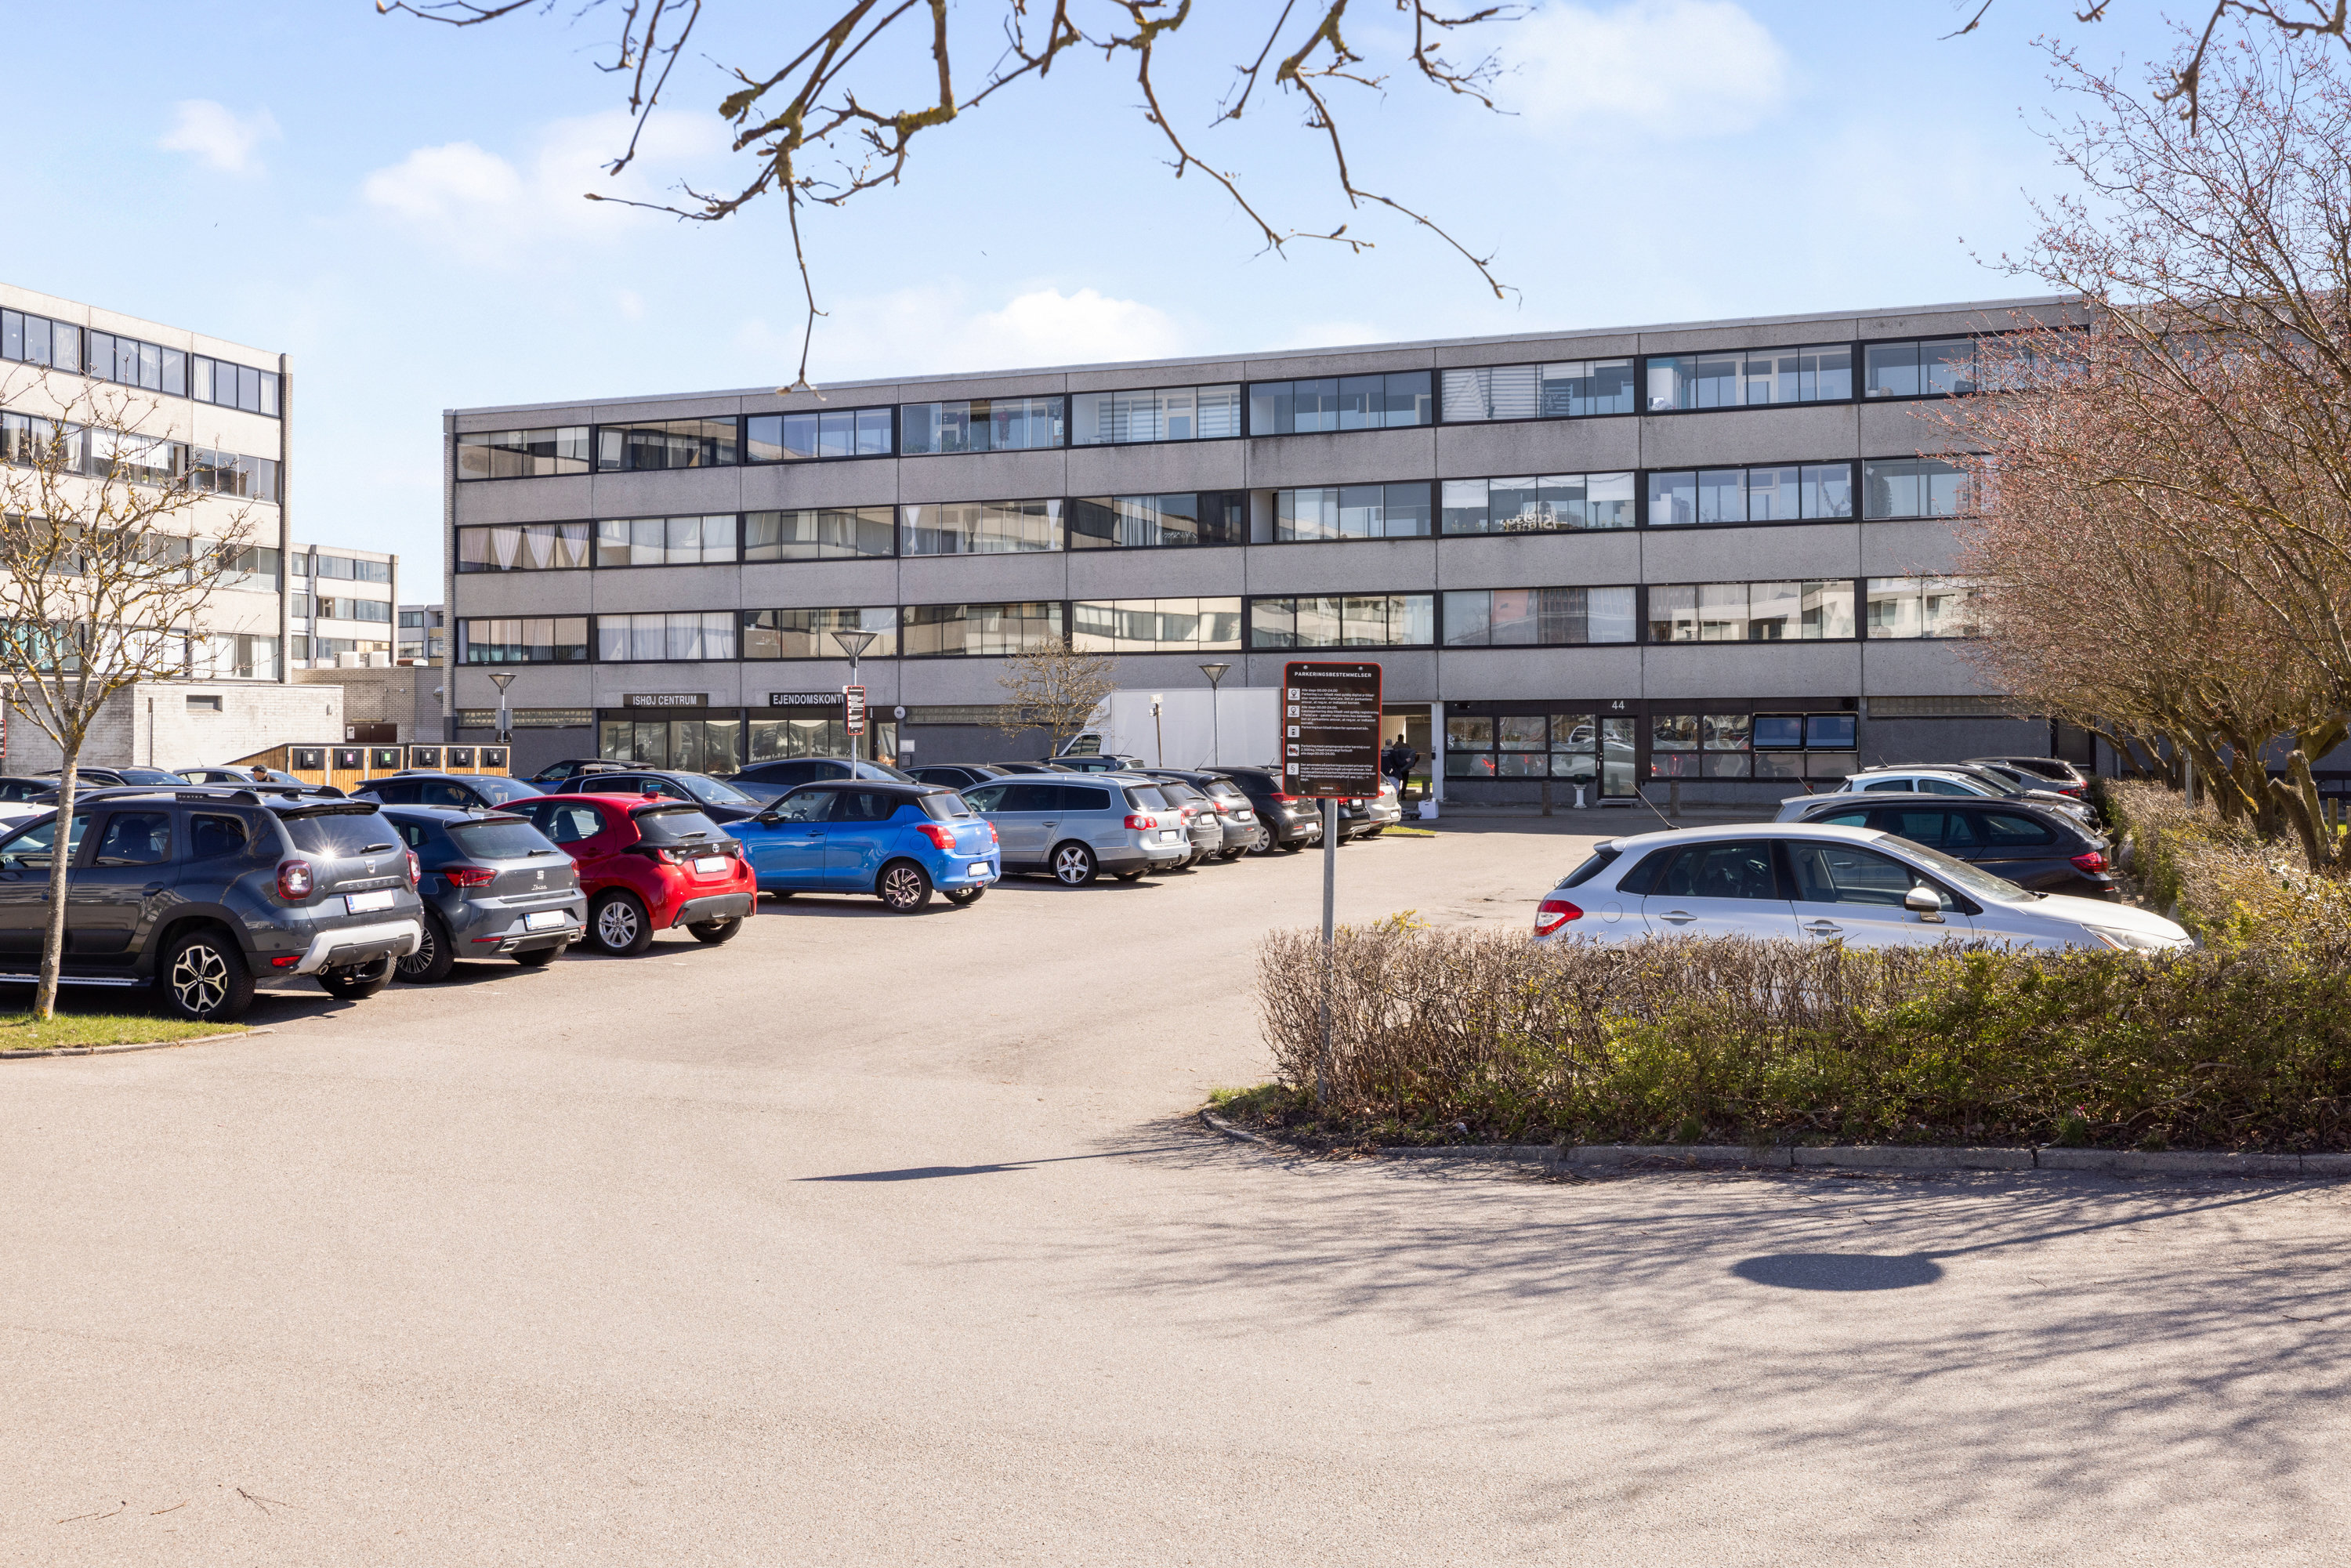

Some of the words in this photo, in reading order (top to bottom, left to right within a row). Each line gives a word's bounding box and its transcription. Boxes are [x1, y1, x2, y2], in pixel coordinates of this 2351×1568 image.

[633, 695, 656, 705] ISHØJ
[658, 695, 697, 705] CENTRUM
[773, 694, 843, 704] EJENDOMSKONT
[1611, 700, 1625, 710] 44
[348, 879, 395, 889] DUSTER
